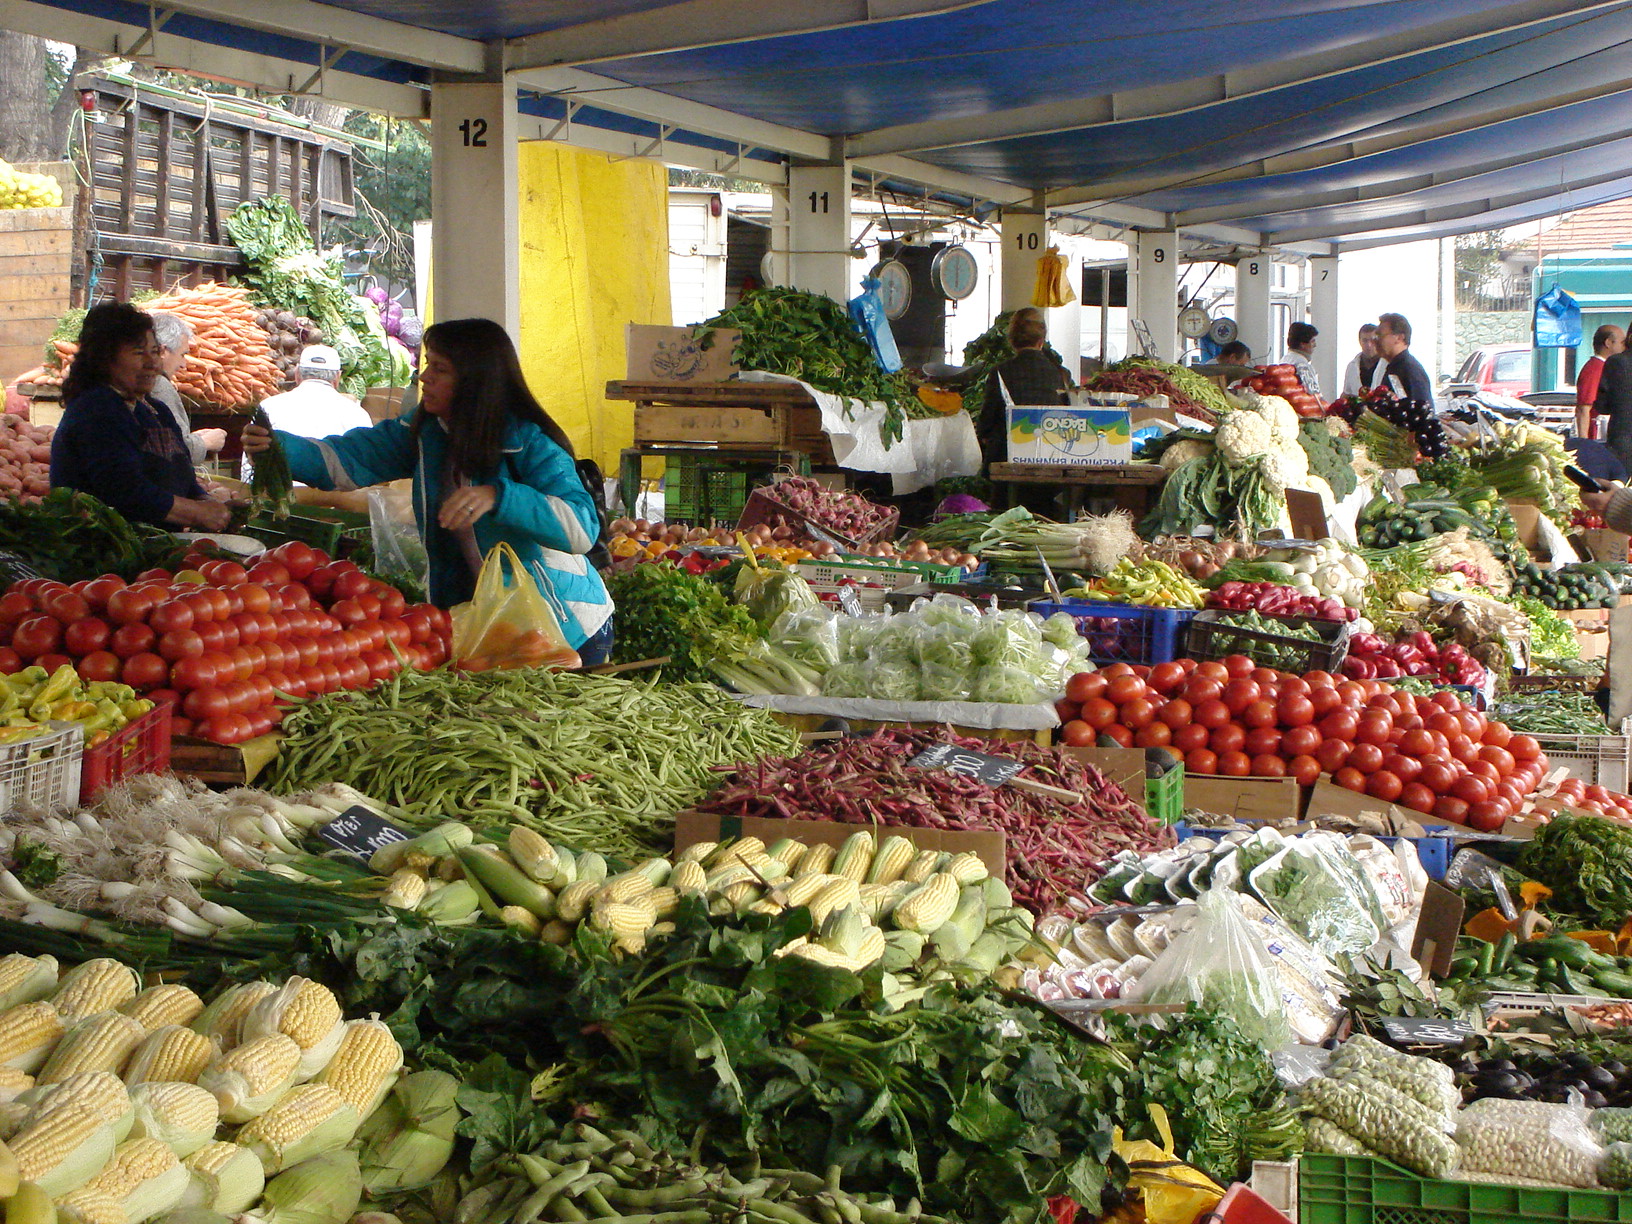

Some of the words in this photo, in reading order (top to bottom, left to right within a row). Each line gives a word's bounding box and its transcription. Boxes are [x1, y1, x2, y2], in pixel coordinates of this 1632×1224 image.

[458, 118, 487, 147] 12
[808, 191, 829, 214] 11
[1015, 232, 1038, 251] 10
[1154, 247, 1165, 264] 9
[1249, 262, 1259, 276] 8
[1321, 269, 1329, 282] 7
[1041, 417, 1088, 433] BAGNO
